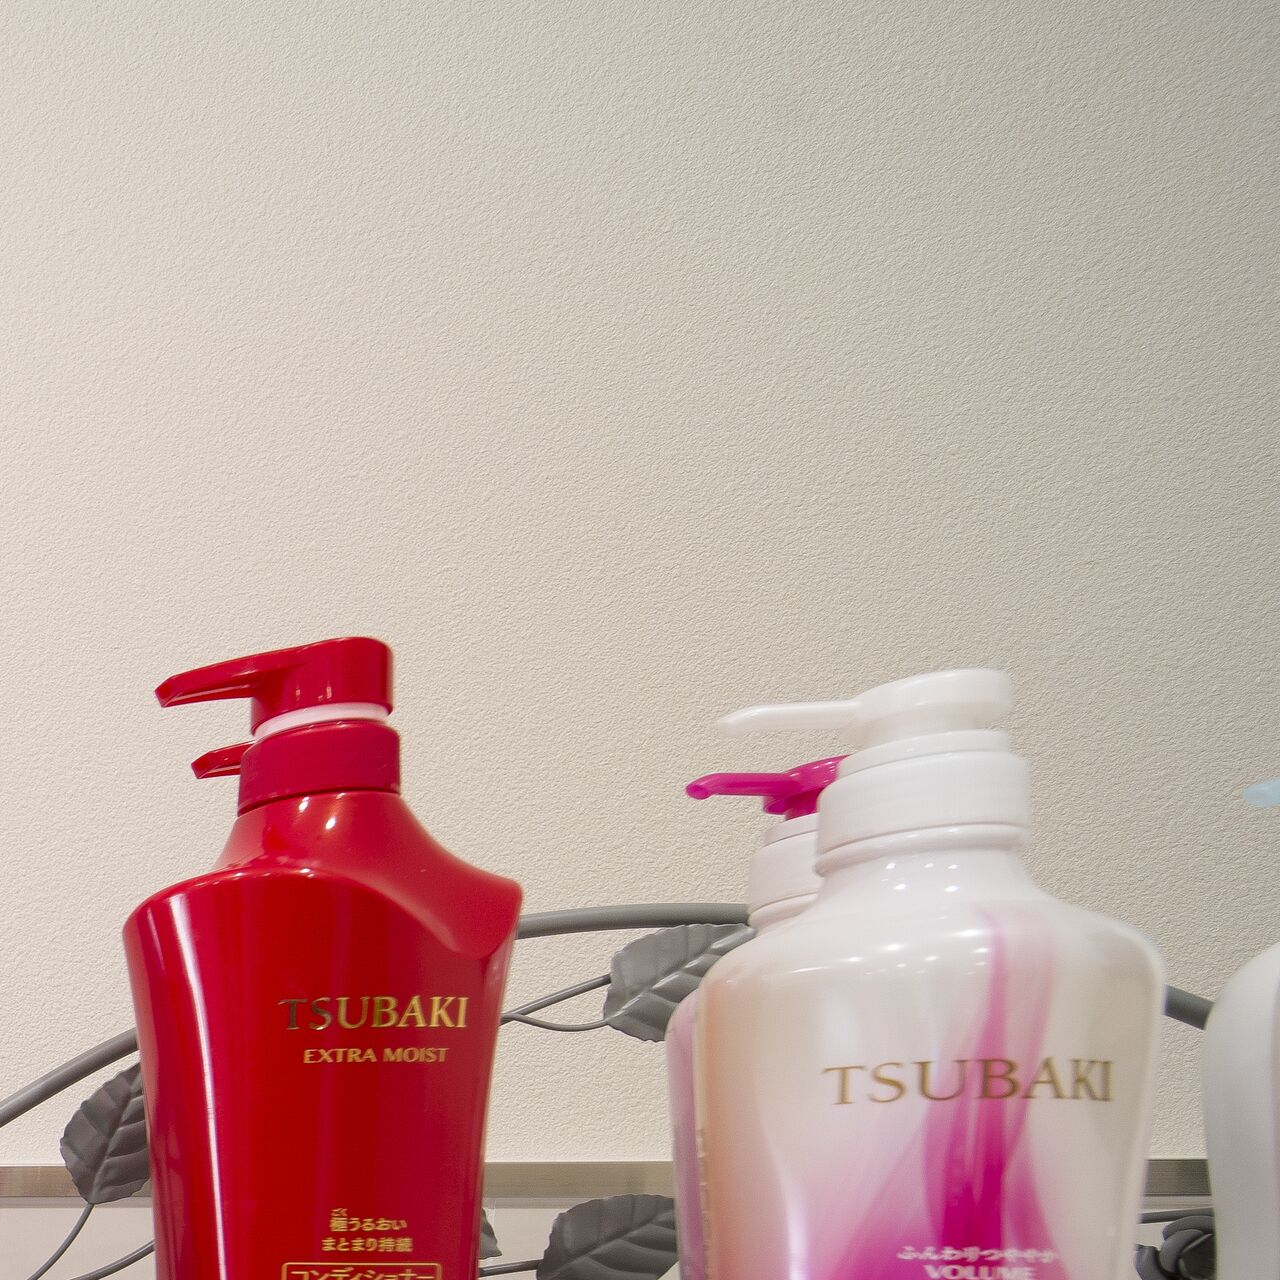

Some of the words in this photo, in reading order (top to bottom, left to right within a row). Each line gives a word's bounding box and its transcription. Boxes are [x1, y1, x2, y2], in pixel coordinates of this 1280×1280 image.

[277, 995, 469, 1031] TSUBAKI
[303, 1048, 377, 1064] EXTRA
[383, 1046, 450, 1063] MOIST
[821, 1057, 1115, 1105] TSUBAKI
